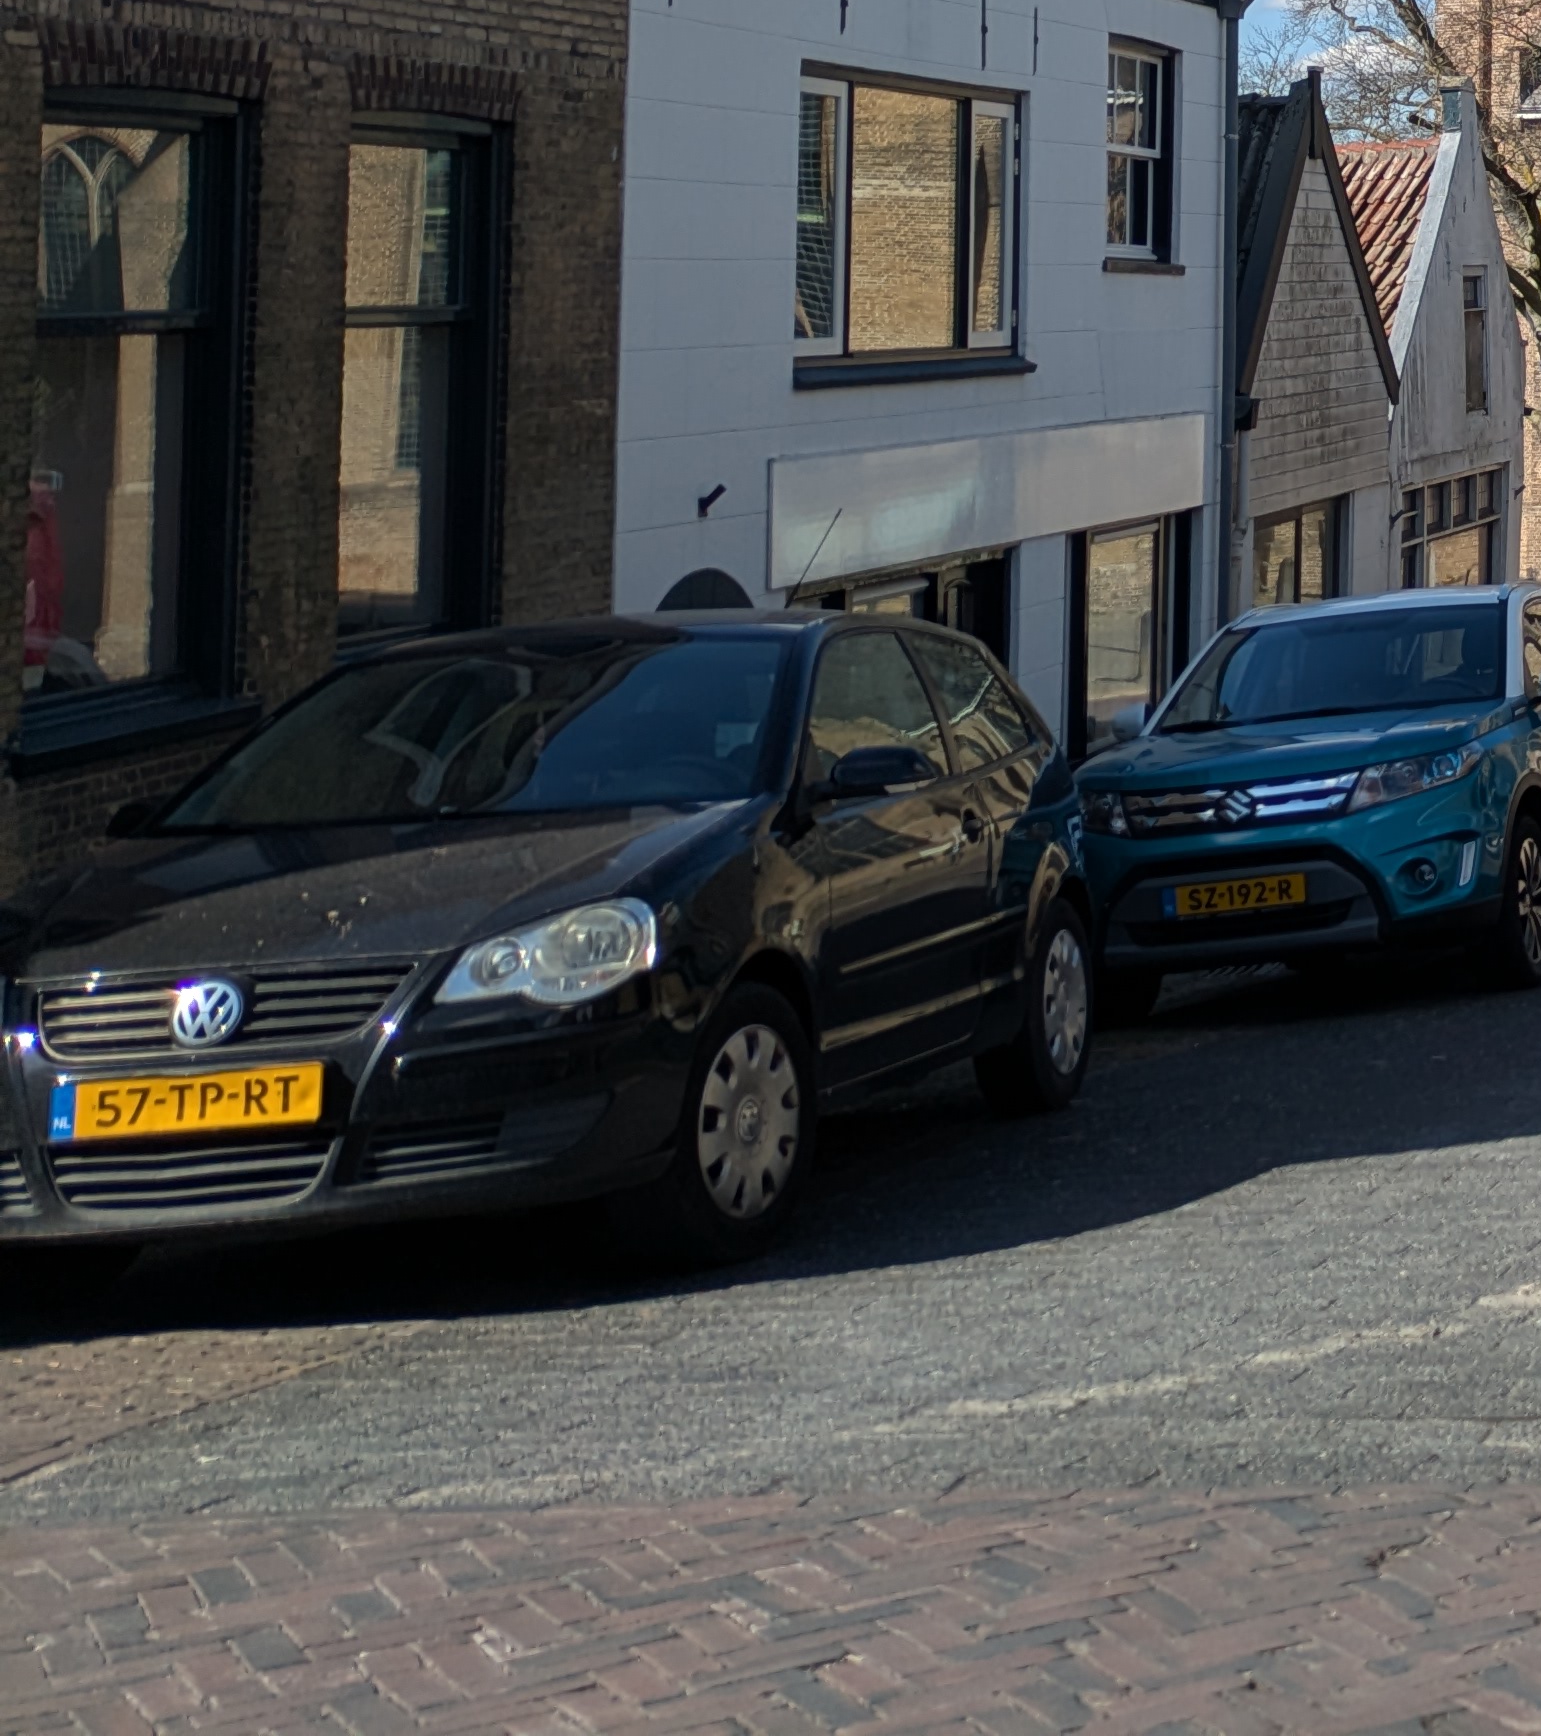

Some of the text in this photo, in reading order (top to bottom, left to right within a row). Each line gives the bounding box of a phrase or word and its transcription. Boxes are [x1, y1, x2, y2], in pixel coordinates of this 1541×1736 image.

[1188, 879, 1293, 911] SZ-192-R
[95, 1074, 299, 1128] 57-TP-RT
[53, 1115, 72, 1131] NL
